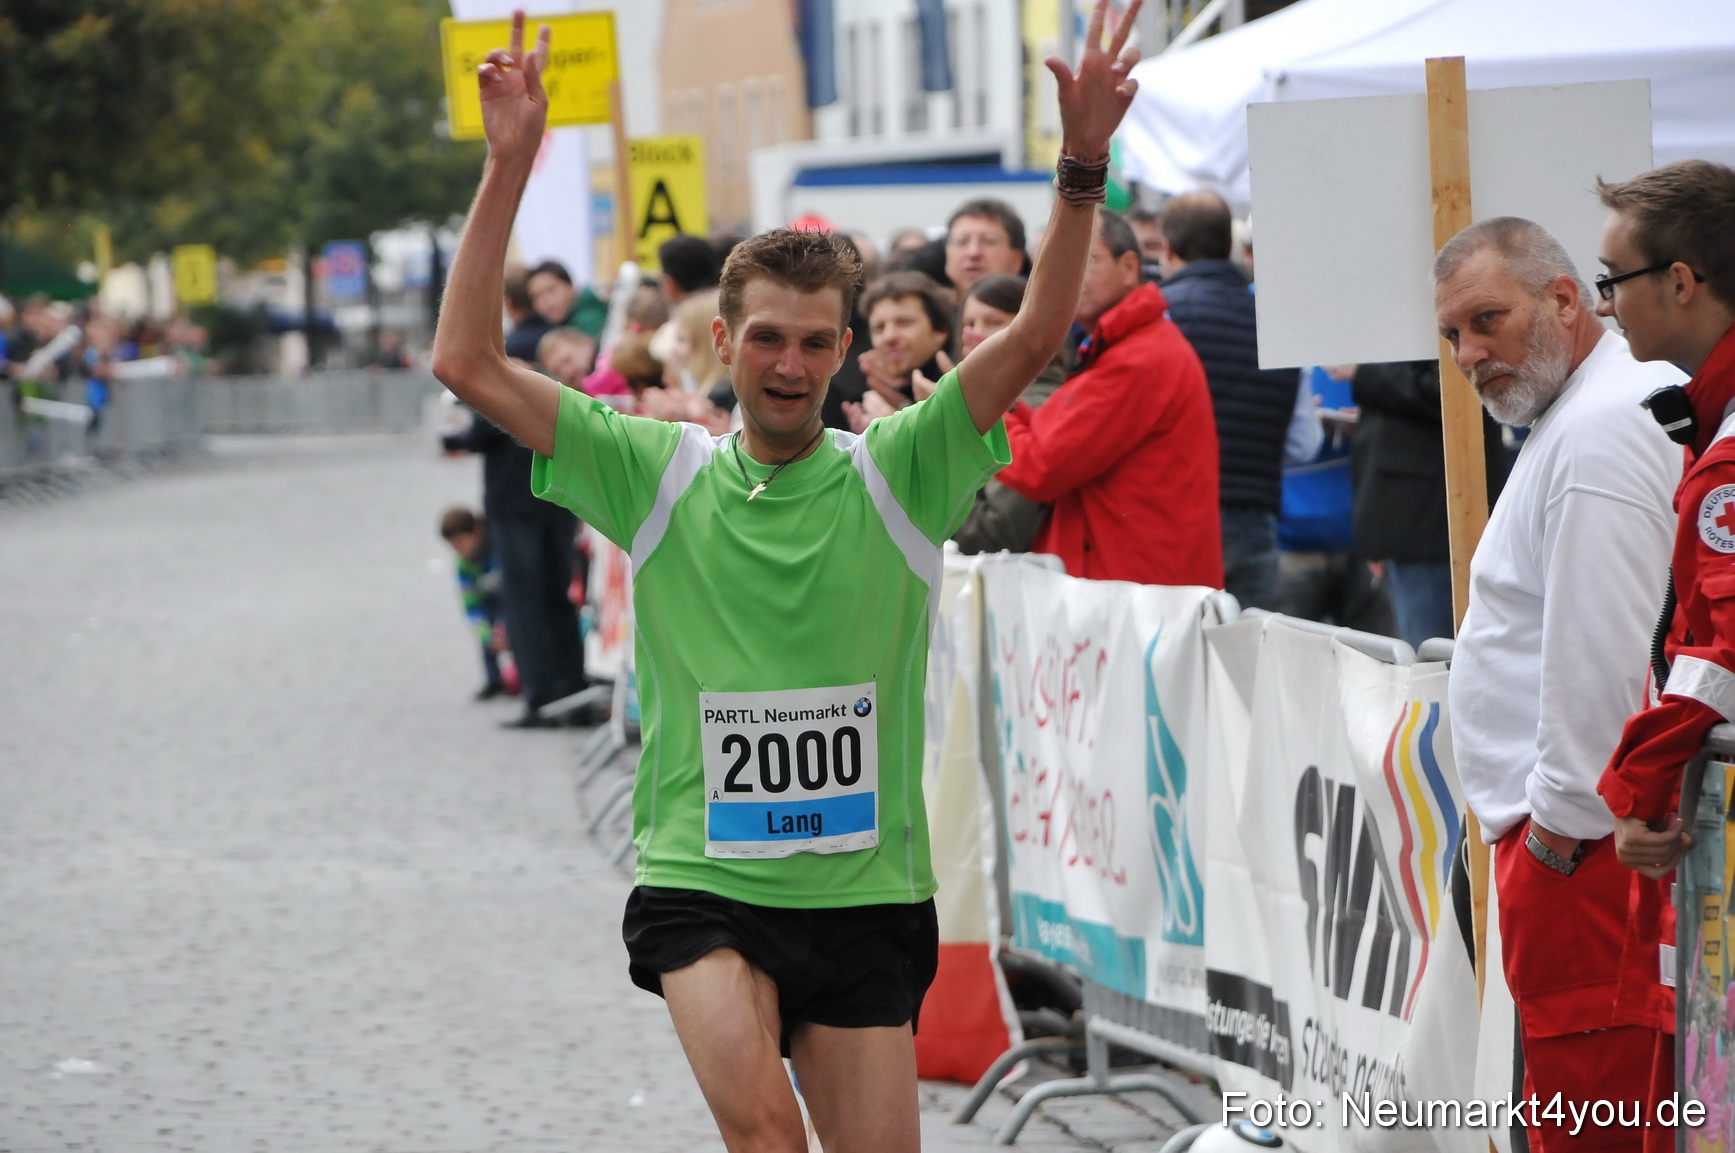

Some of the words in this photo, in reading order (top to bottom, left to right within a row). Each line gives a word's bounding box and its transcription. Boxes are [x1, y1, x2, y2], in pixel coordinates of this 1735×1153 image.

[639, 178, 682, 238] A
[1704, 526, 1734, 549] ROTES
[704, 709, 760, 724] PARTL
[764, 703, 847, 723] Neumarkt
[721, 725, 862, 794] 2000
[712, 789, 720, 801] A
[766, 811, 823, 837] Lang
